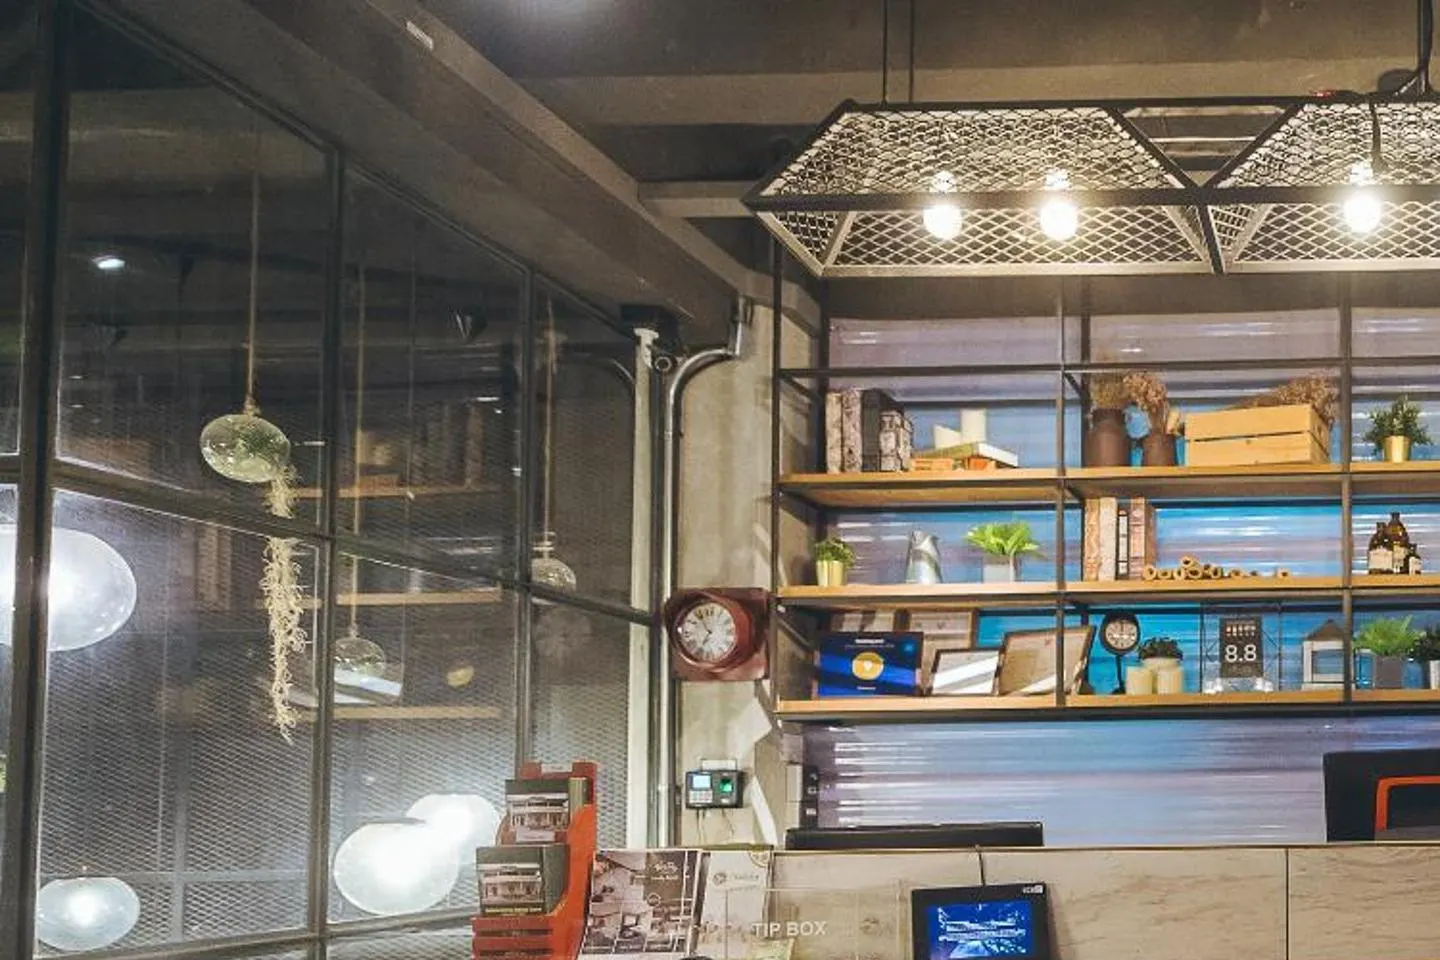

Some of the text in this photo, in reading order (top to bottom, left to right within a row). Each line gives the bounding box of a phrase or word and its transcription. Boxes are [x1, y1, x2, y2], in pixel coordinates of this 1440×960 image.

[1225, 644, 1257, 662] 8.8
[753, 920, 827, 938] TIP BOX
